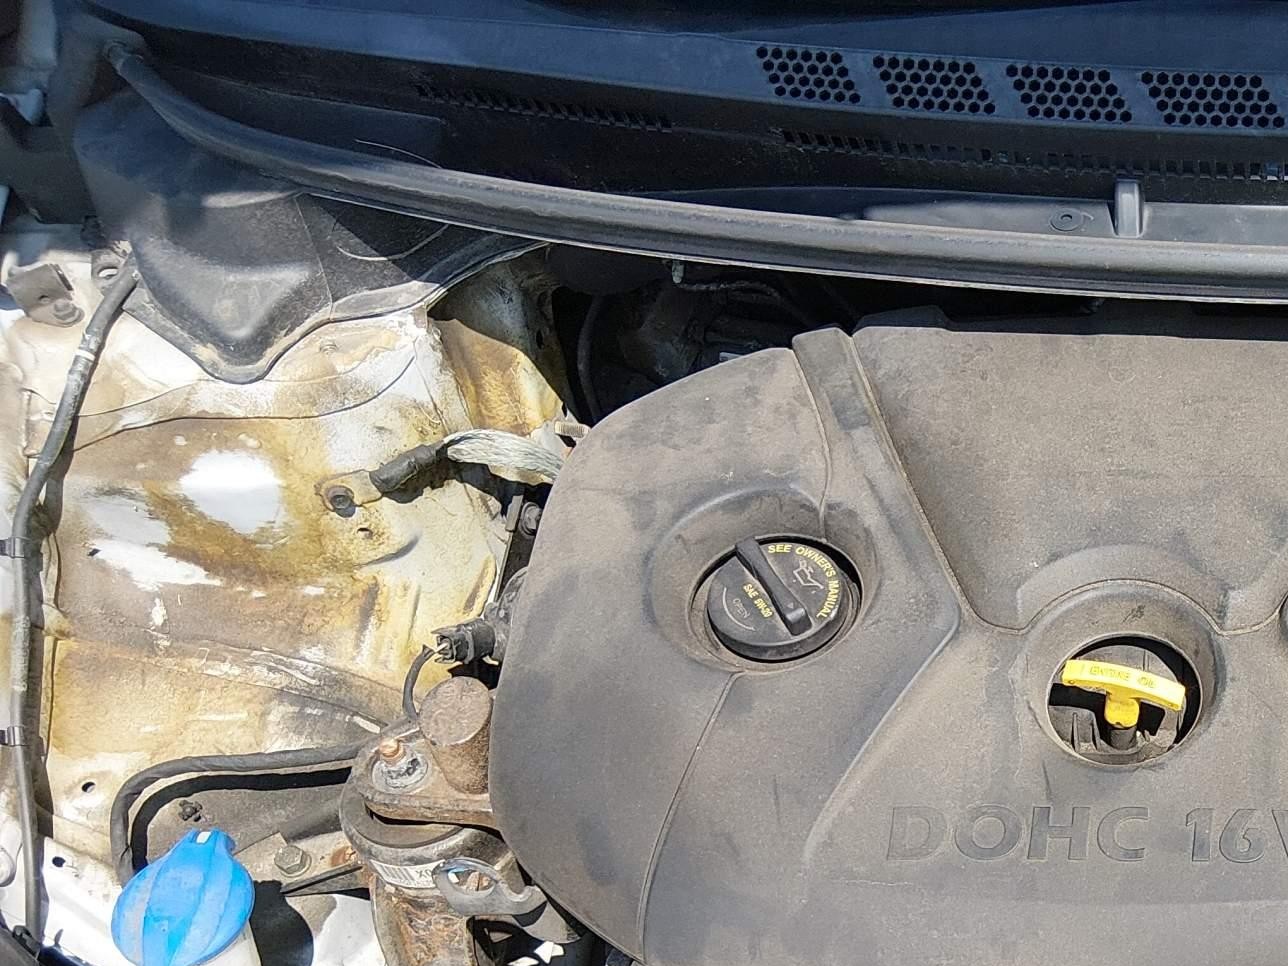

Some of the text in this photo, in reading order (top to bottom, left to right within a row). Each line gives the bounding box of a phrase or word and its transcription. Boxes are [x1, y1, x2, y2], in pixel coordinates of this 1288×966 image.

[743, 583, 759, 599] SAE
[767, 544, 840, 619] SEE OWNER'S MANUAL
[732, 598, 751, 619] OPEN
[886, 804, 1149, 863] DOHC
